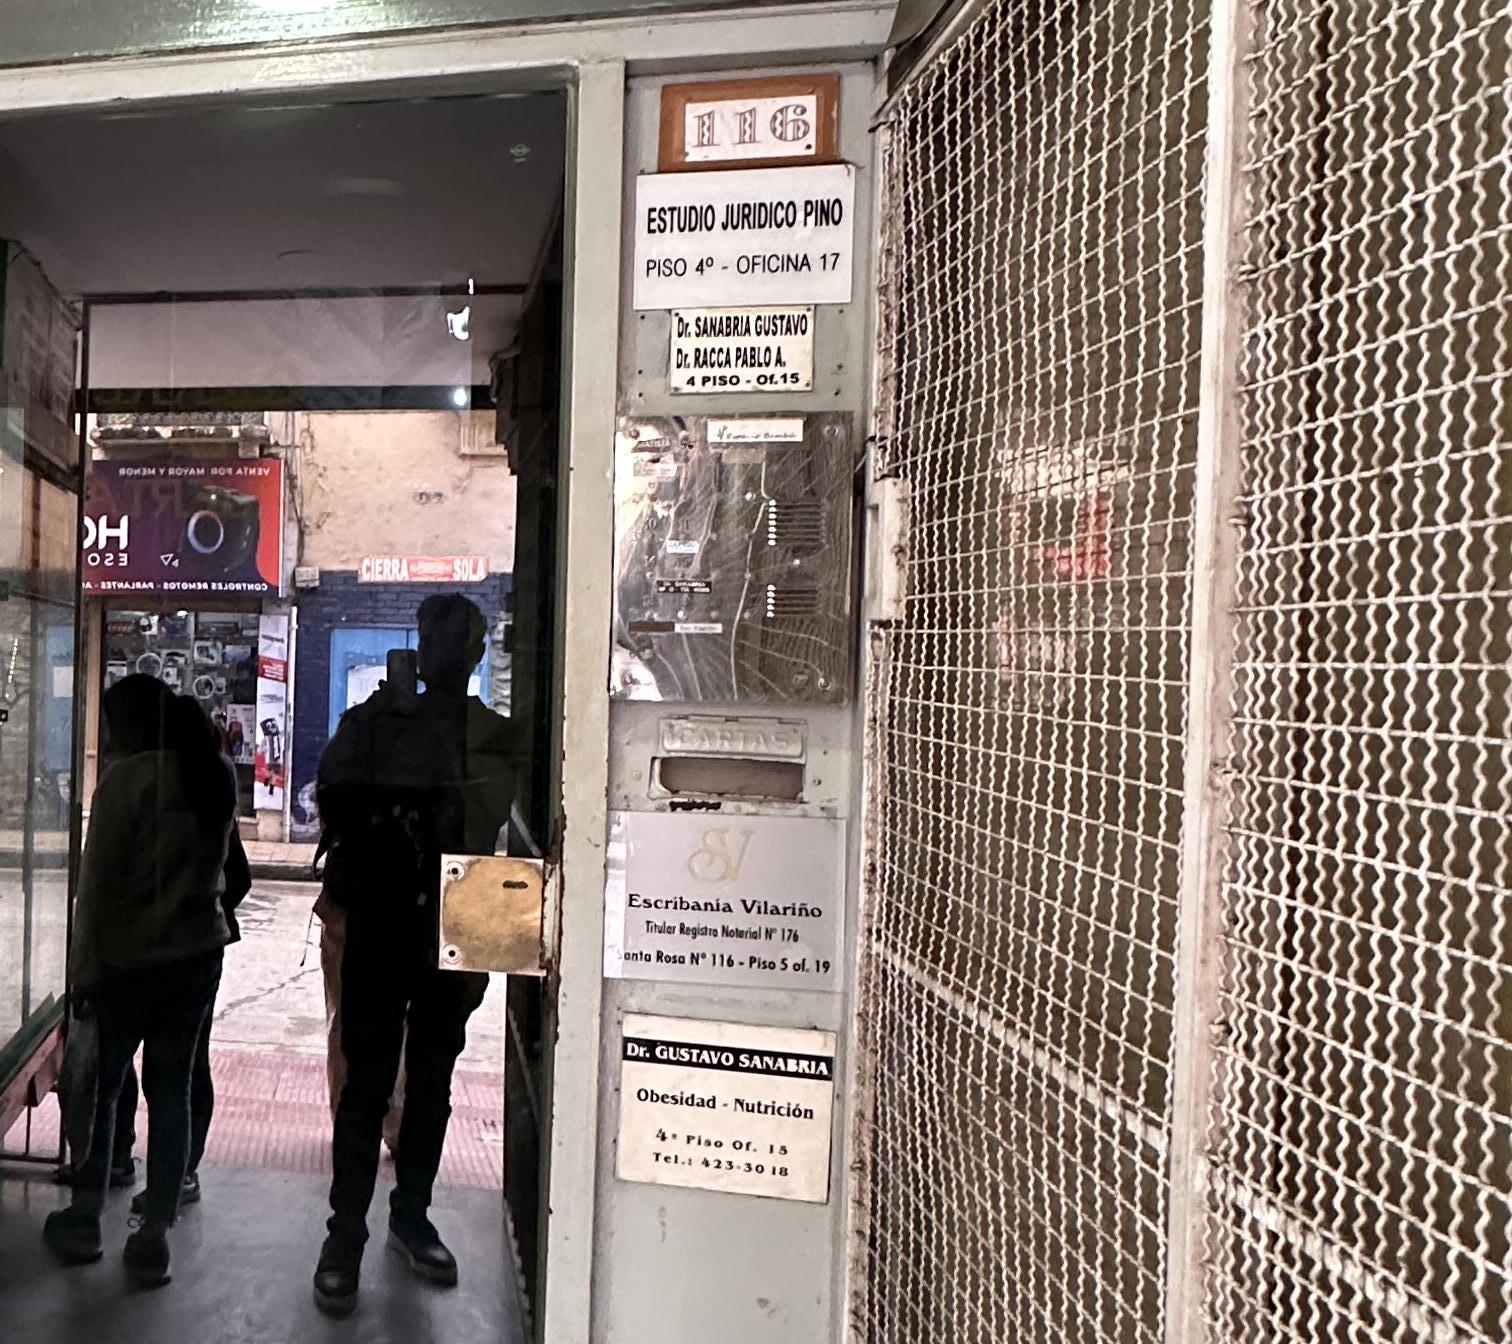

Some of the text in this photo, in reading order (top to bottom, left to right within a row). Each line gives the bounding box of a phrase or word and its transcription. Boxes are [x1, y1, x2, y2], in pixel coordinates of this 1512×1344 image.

[693, 104, 811, 147] 116
[647, 198, 843, 234] ESTUDIO JURIDICO PINO
[646, 258, 687, 278] PISO
[736, 254, 811, 274] OFICINA
[819, 253, 840, 272] 17
[677, 314, 808, 338] Dr. SANABRIA GUSTAVO
[676, 346, 786, 369] Dr. RACCA PABLO A.
[686, 376, 695, 386] 4
[701, 375, 740, 386] PISO
[361, 557, 409, 582] CIERRA
[453, 557, 486, 582] SOLA
[679, 726, 789, 751] CARTAS
[741, 899, 823, 918] Vilariño
[645, 920, 676, 935] Titular
[679, 923, 718, 940] Registro
[721, 926, 761, 940] Notarial
[782, 929, 799, 943] 176
[656, 951, 685, 964] Rosa
[712, 954, 734, 967] 116
[749, 956, 775, 970] Piso
[781, 957, 788, 970] 5
[793, 958, 810, 973] of.
[815, 960, 830, 973] 19
[626, 1042, 828, 1076] Dr. GUSTAVO SANABRIA
[636, 1088, 716, 1109] Obesidad
[734, 1098, 814, 1120] Nutrición
[686, 1135, 723, 1149] Piso
[732, 1140, 758, 1152] Of.
[769, 1144, 788, 1155] 15
[653, 1151, 693, 1166] Tel.:
